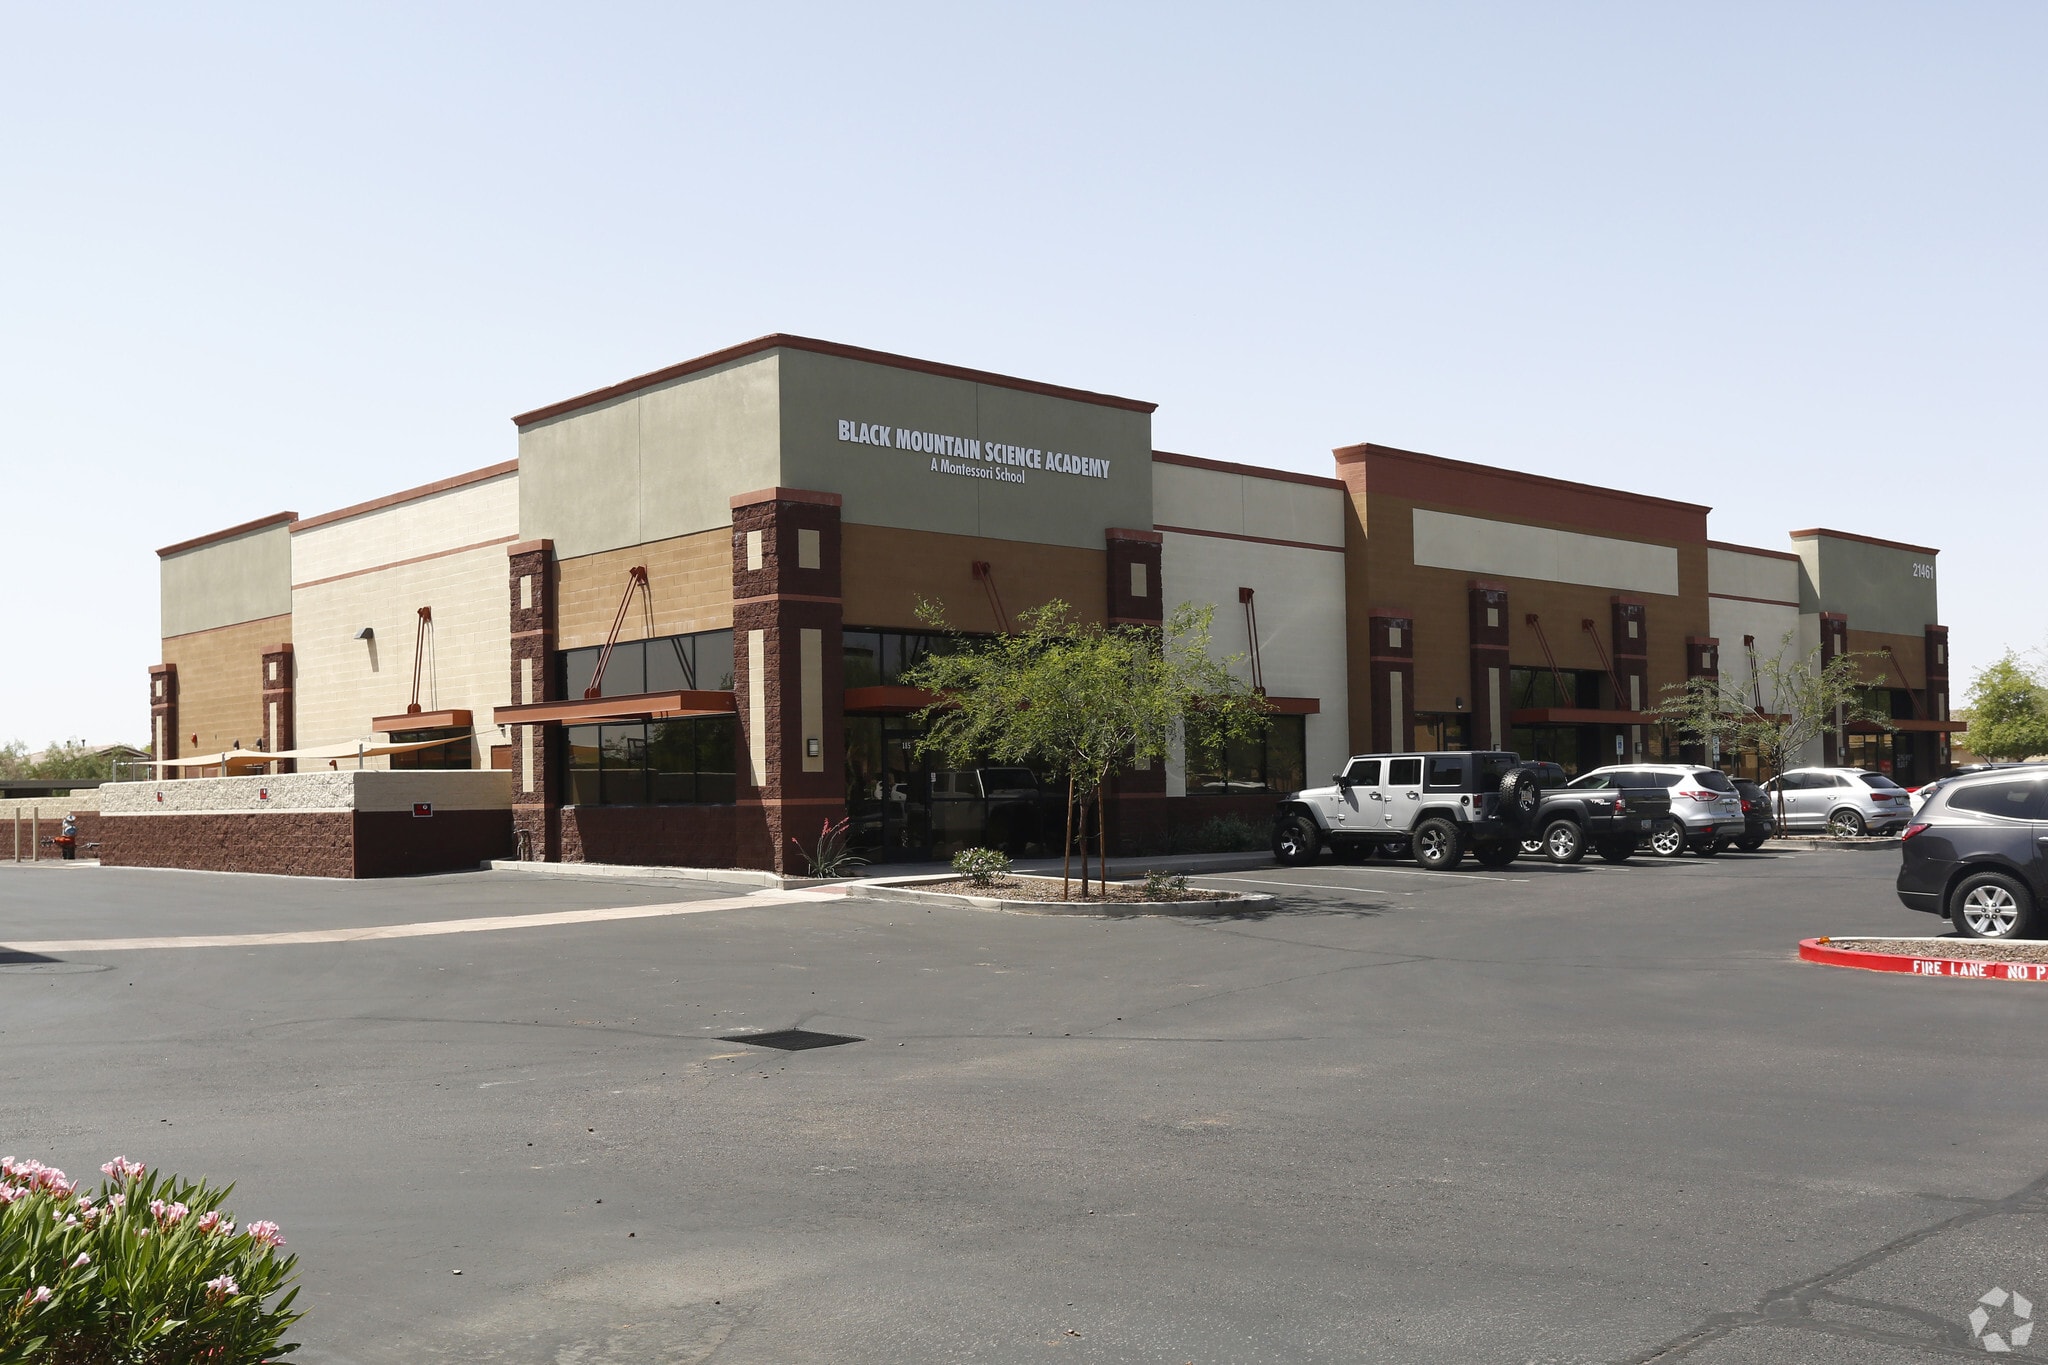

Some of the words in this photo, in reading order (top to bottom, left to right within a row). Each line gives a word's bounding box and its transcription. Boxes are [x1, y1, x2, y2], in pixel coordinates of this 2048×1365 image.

[838, 419, 892, 448] BLACK
[895, 428, 981, 460] MOUNTAIN
[985, 442, 1042, 469] SCIENCE
[1044, 451, 1111, 479] ACADEMY
[930, 457, 939, 472] A
[940, 459, 993, 481] Montessori
[995, 466, 1026, 484] School
[1912, 562, 1934, 580] 21461
[1913, 960, 1942, 975] FIRE
[1950, 962, 1987, 977] LANE
[2007, 965, 2028, 979] NO
[2036, 966, 2048, 980] P
